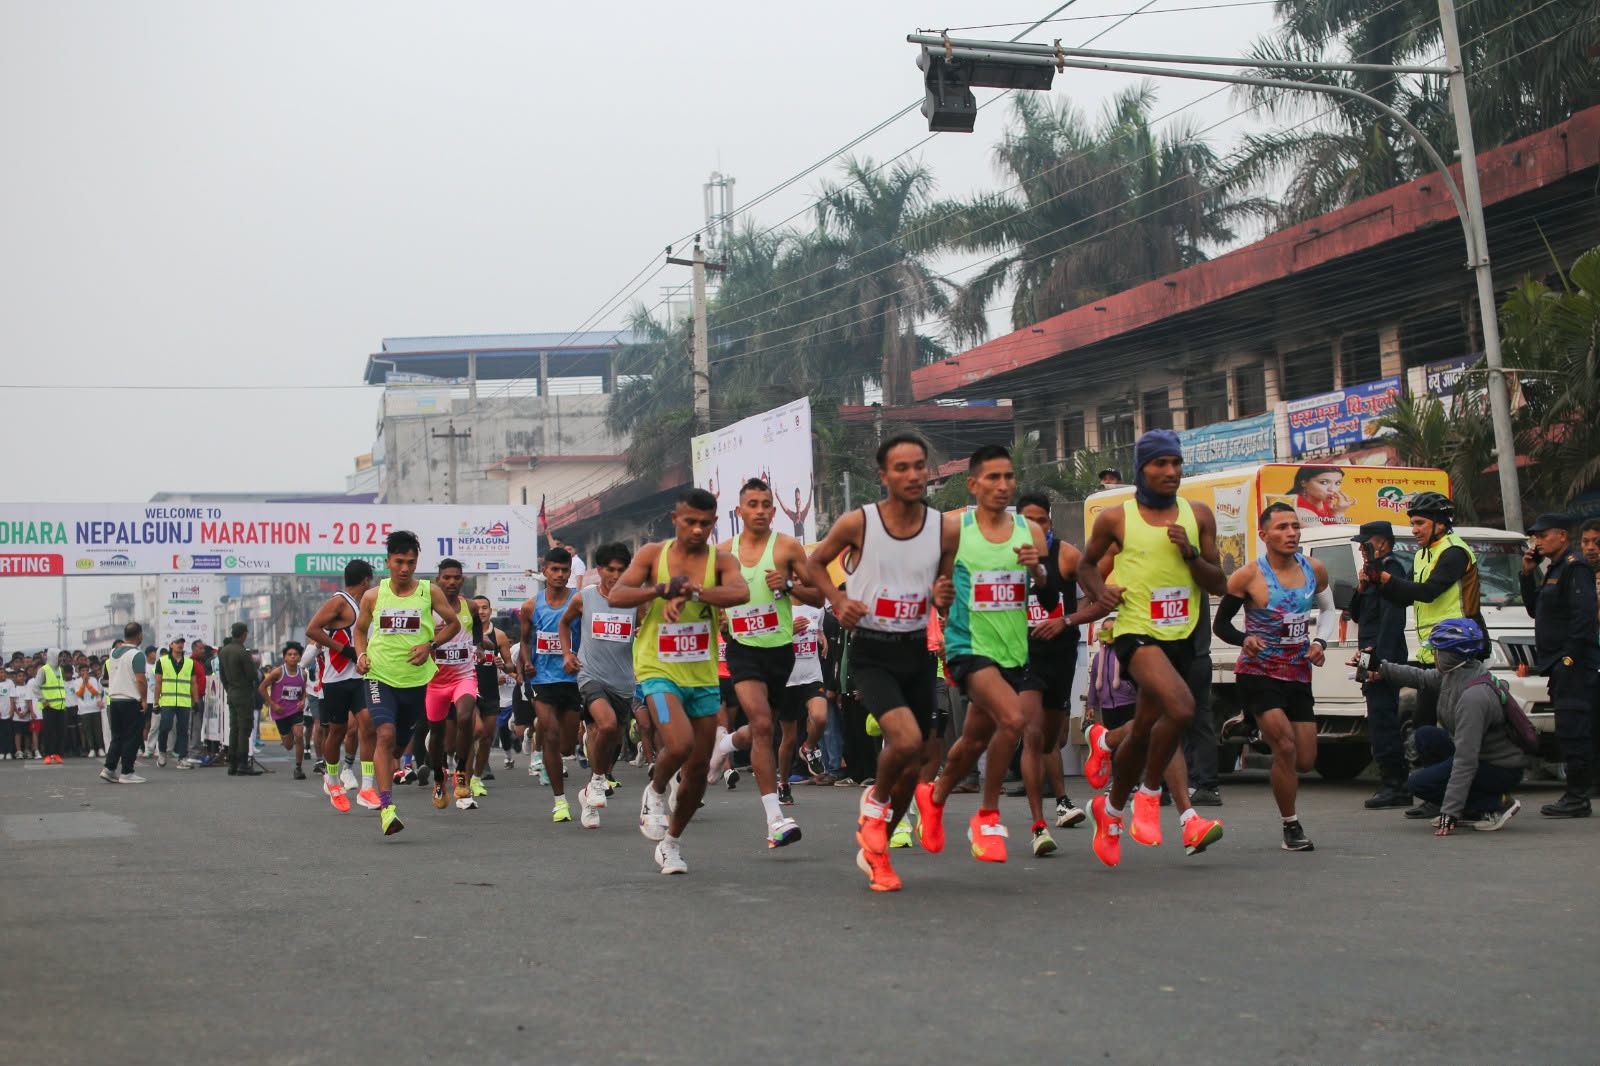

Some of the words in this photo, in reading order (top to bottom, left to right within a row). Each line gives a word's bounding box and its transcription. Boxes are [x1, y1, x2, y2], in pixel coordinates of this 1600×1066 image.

[145, 508, 203, 519] WELCOME
[207, 508, 222, 519] TO
[76, 521, 193, 544] NEPALGUNJ
[201, 521, 310, 545] MARATHON
[990, 585, 1015, 601] 106
[893, 602, 919, 619] 130
[1160, 601, 1184, 617] 102
[390, 617, 409, 628] 187
[603, 623, 621, 634] 108
[744, 616, 765, 631] 128
[1288, 623, 1305, 636] 189
[545, 640, 562, 650] 129
[673, 636, 697, 651] 109
[797, 642, 812, 653] 154
[444, 650, 460, 660] 190
